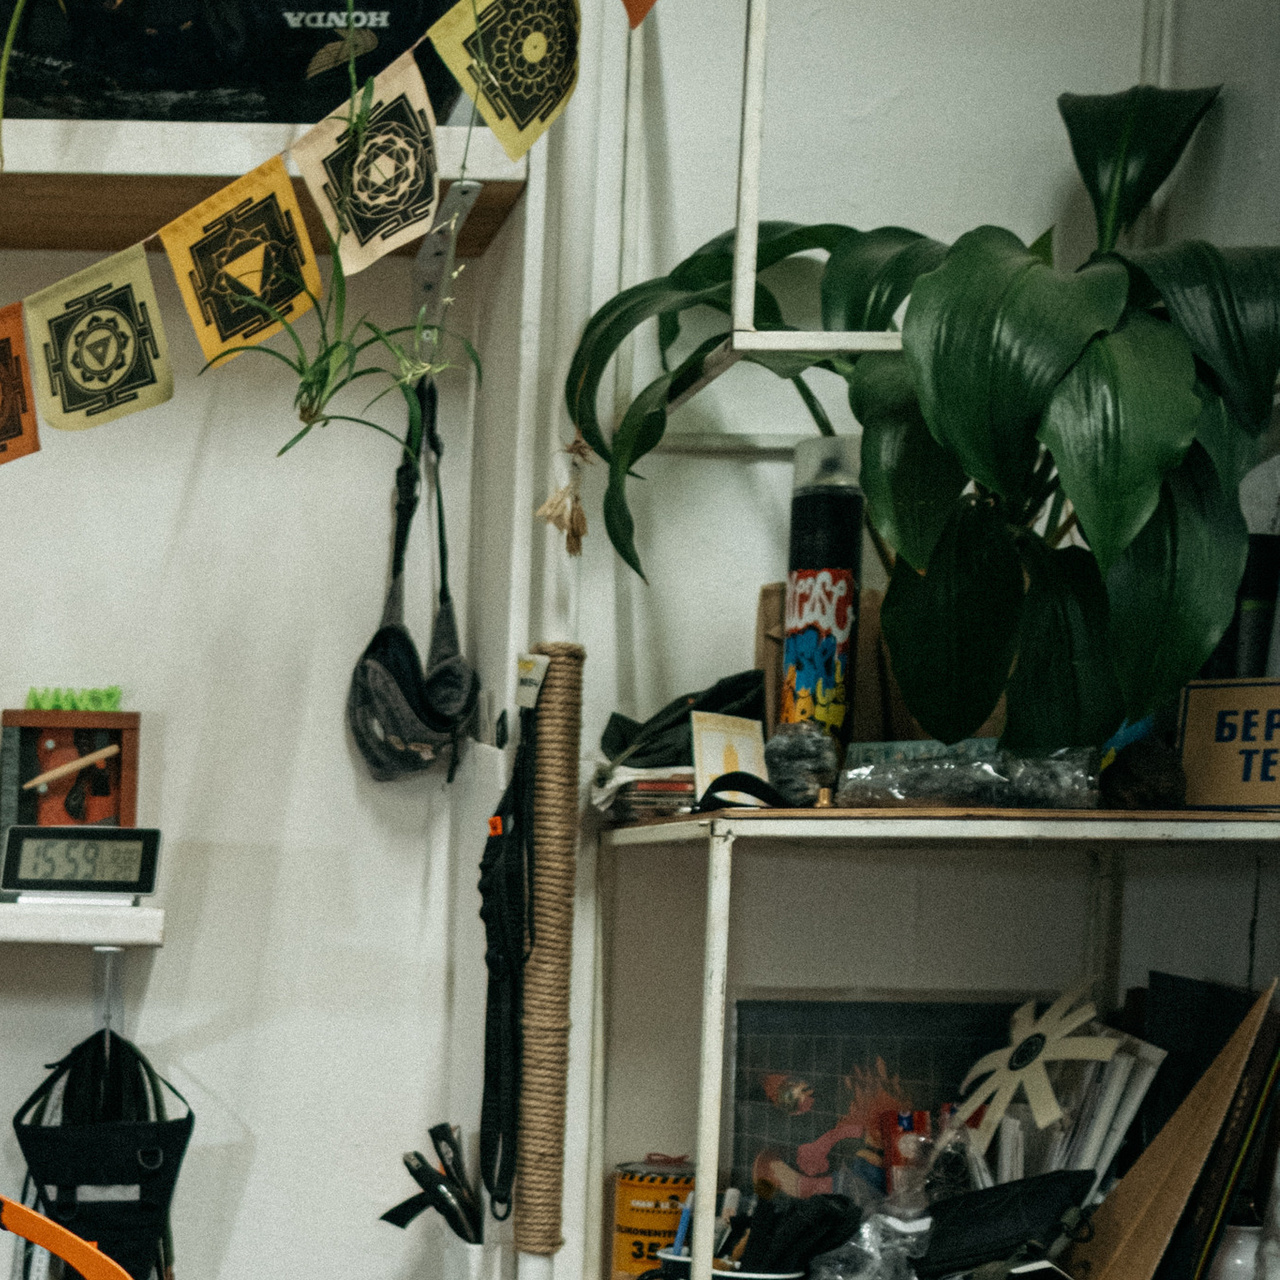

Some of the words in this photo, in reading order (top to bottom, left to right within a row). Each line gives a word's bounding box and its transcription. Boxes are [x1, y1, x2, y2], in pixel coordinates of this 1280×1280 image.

[282, 11, 390, 28] HONDA
[1238, 748, 1279, 782] ТЕ
[631, 1240, 675, 1260] 35
